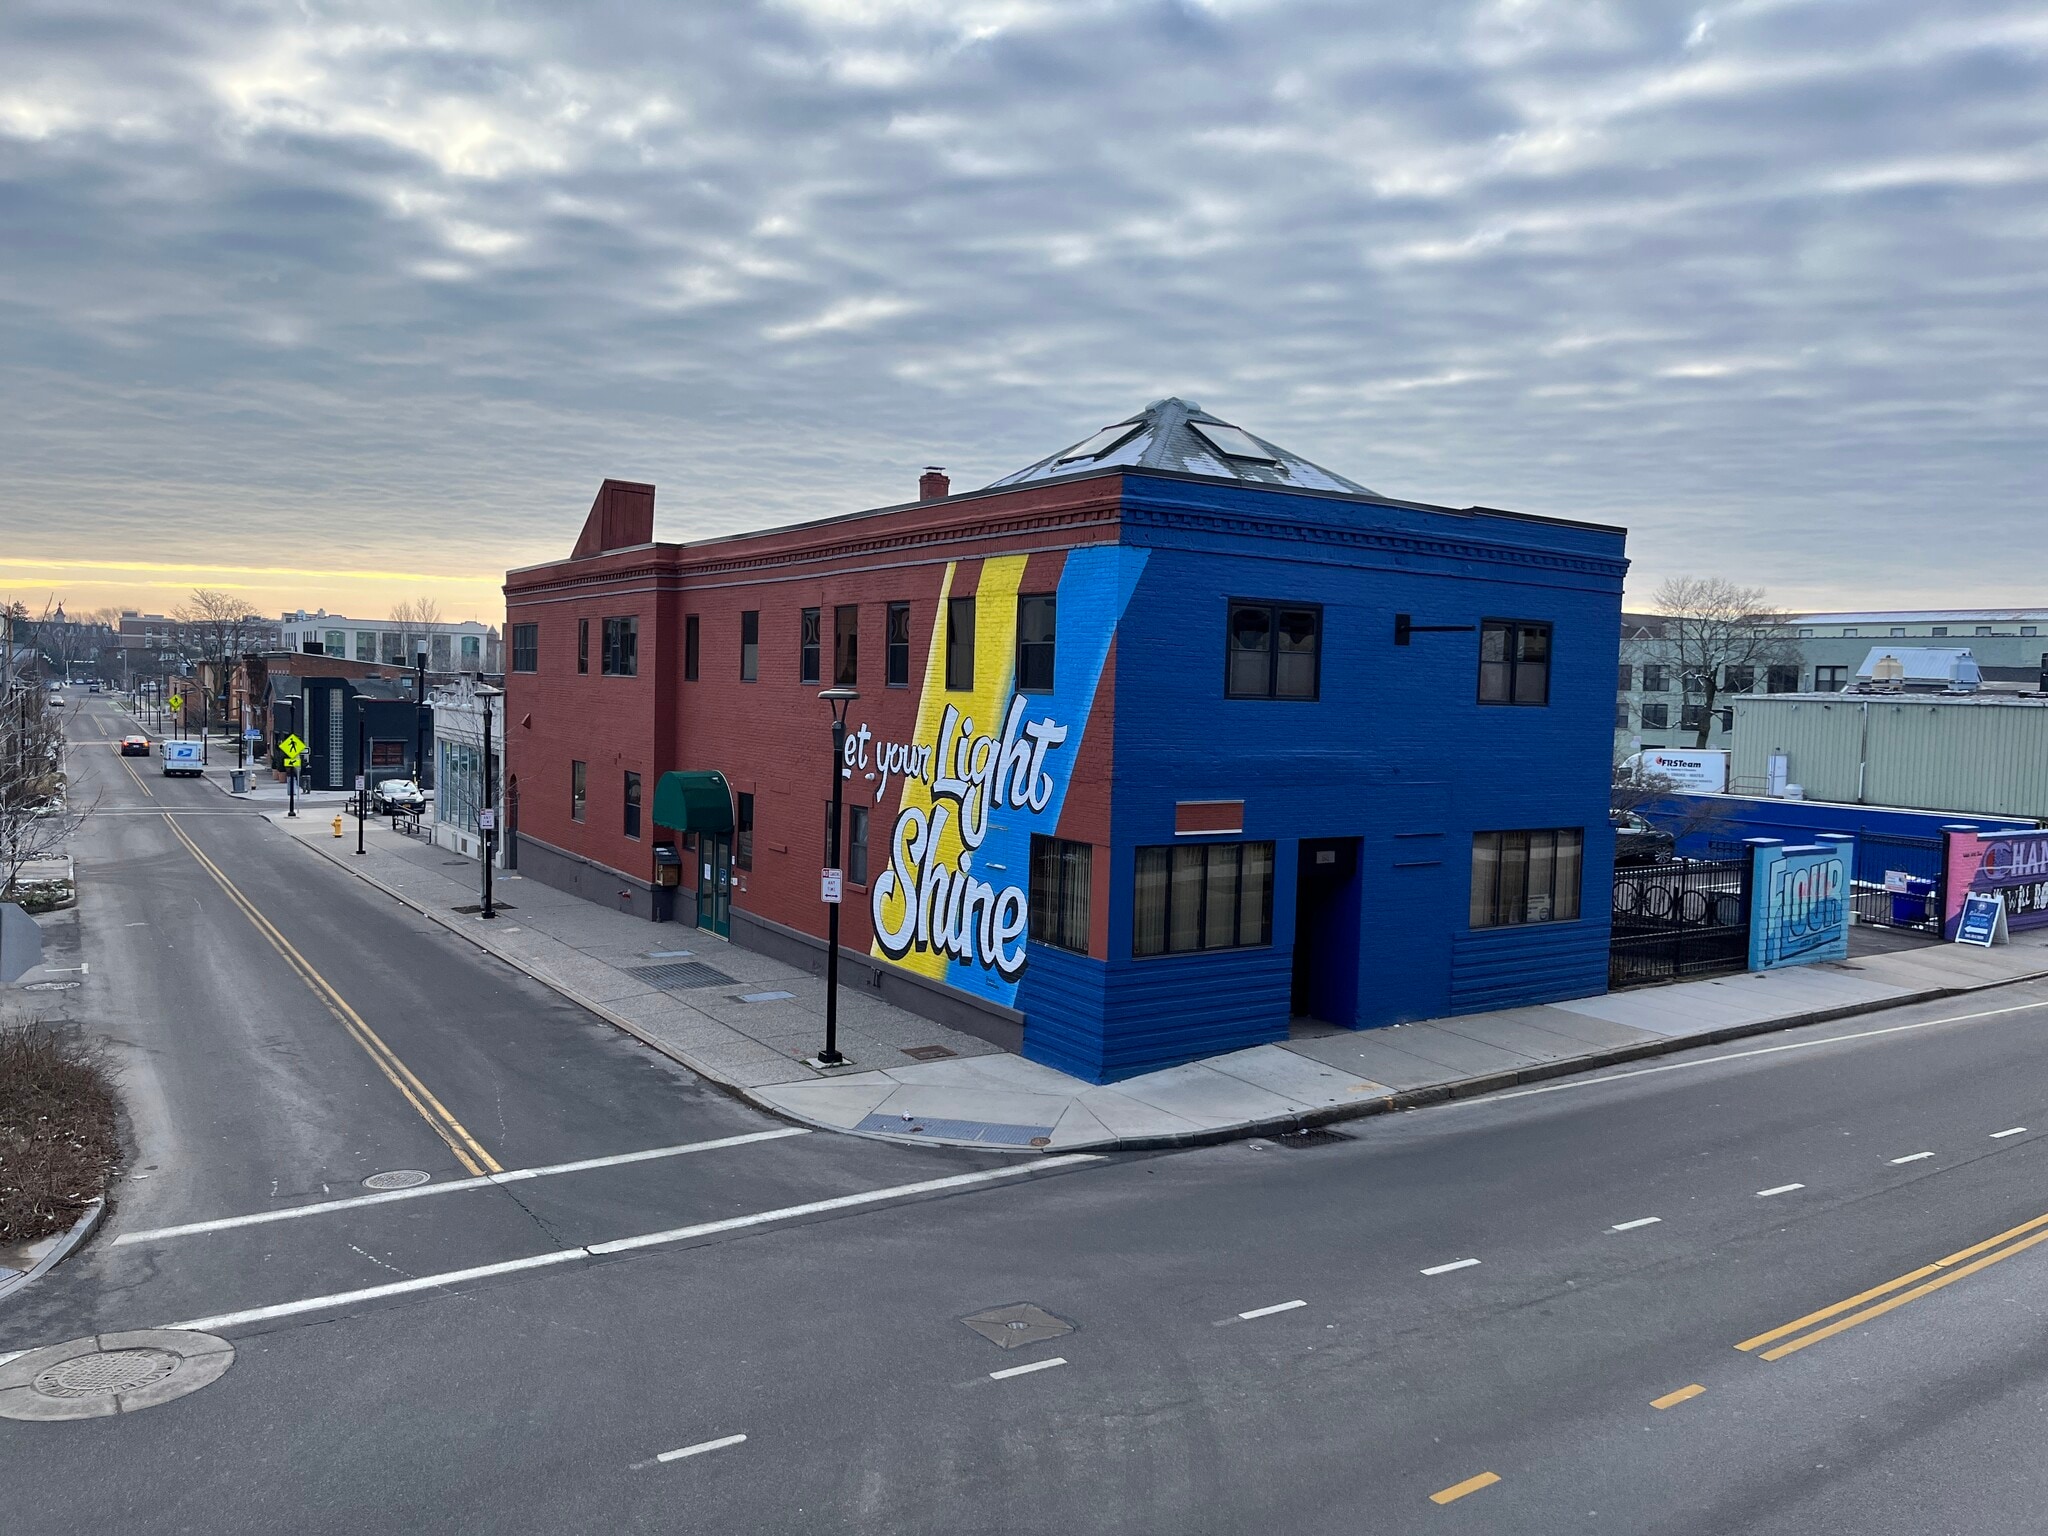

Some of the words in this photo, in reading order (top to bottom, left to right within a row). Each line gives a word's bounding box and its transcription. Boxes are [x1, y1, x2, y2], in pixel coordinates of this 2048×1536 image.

[842, 722, 872, 779] et
[876, 740, 932, 803] your
[931, 692, 1068, 851] Light
[1662, 760, 1701, 768] FRSTeam
[872, 804, 1029, 983] Shine
[1765, 857, 1845, 967] FLOUR
